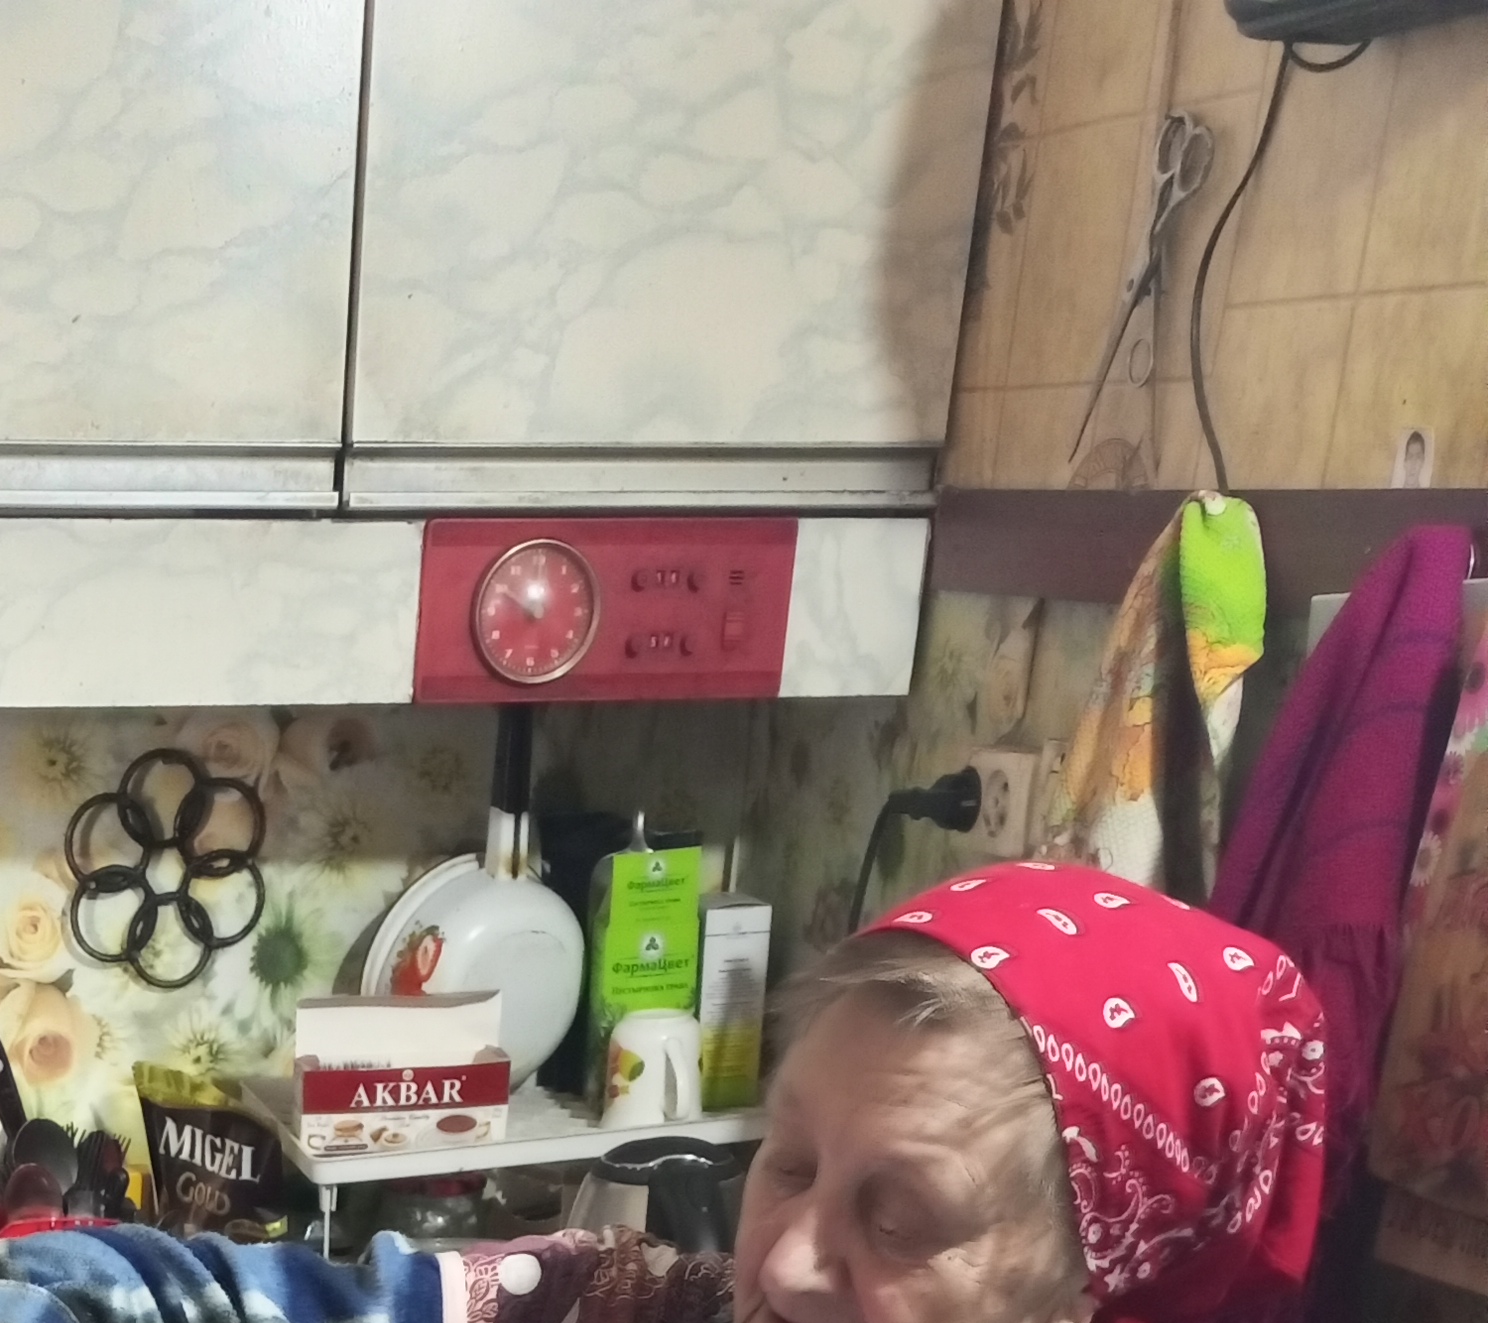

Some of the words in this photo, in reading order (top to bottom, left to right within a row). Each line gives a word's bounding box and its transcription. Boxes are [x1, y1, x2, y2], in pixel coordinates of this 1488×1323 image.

[612, 958, 690, 976] ФармаЦвет
[350, 1079, 464, 1108] AKBAR
[159, 1116, 261, 1183] MIGEL
